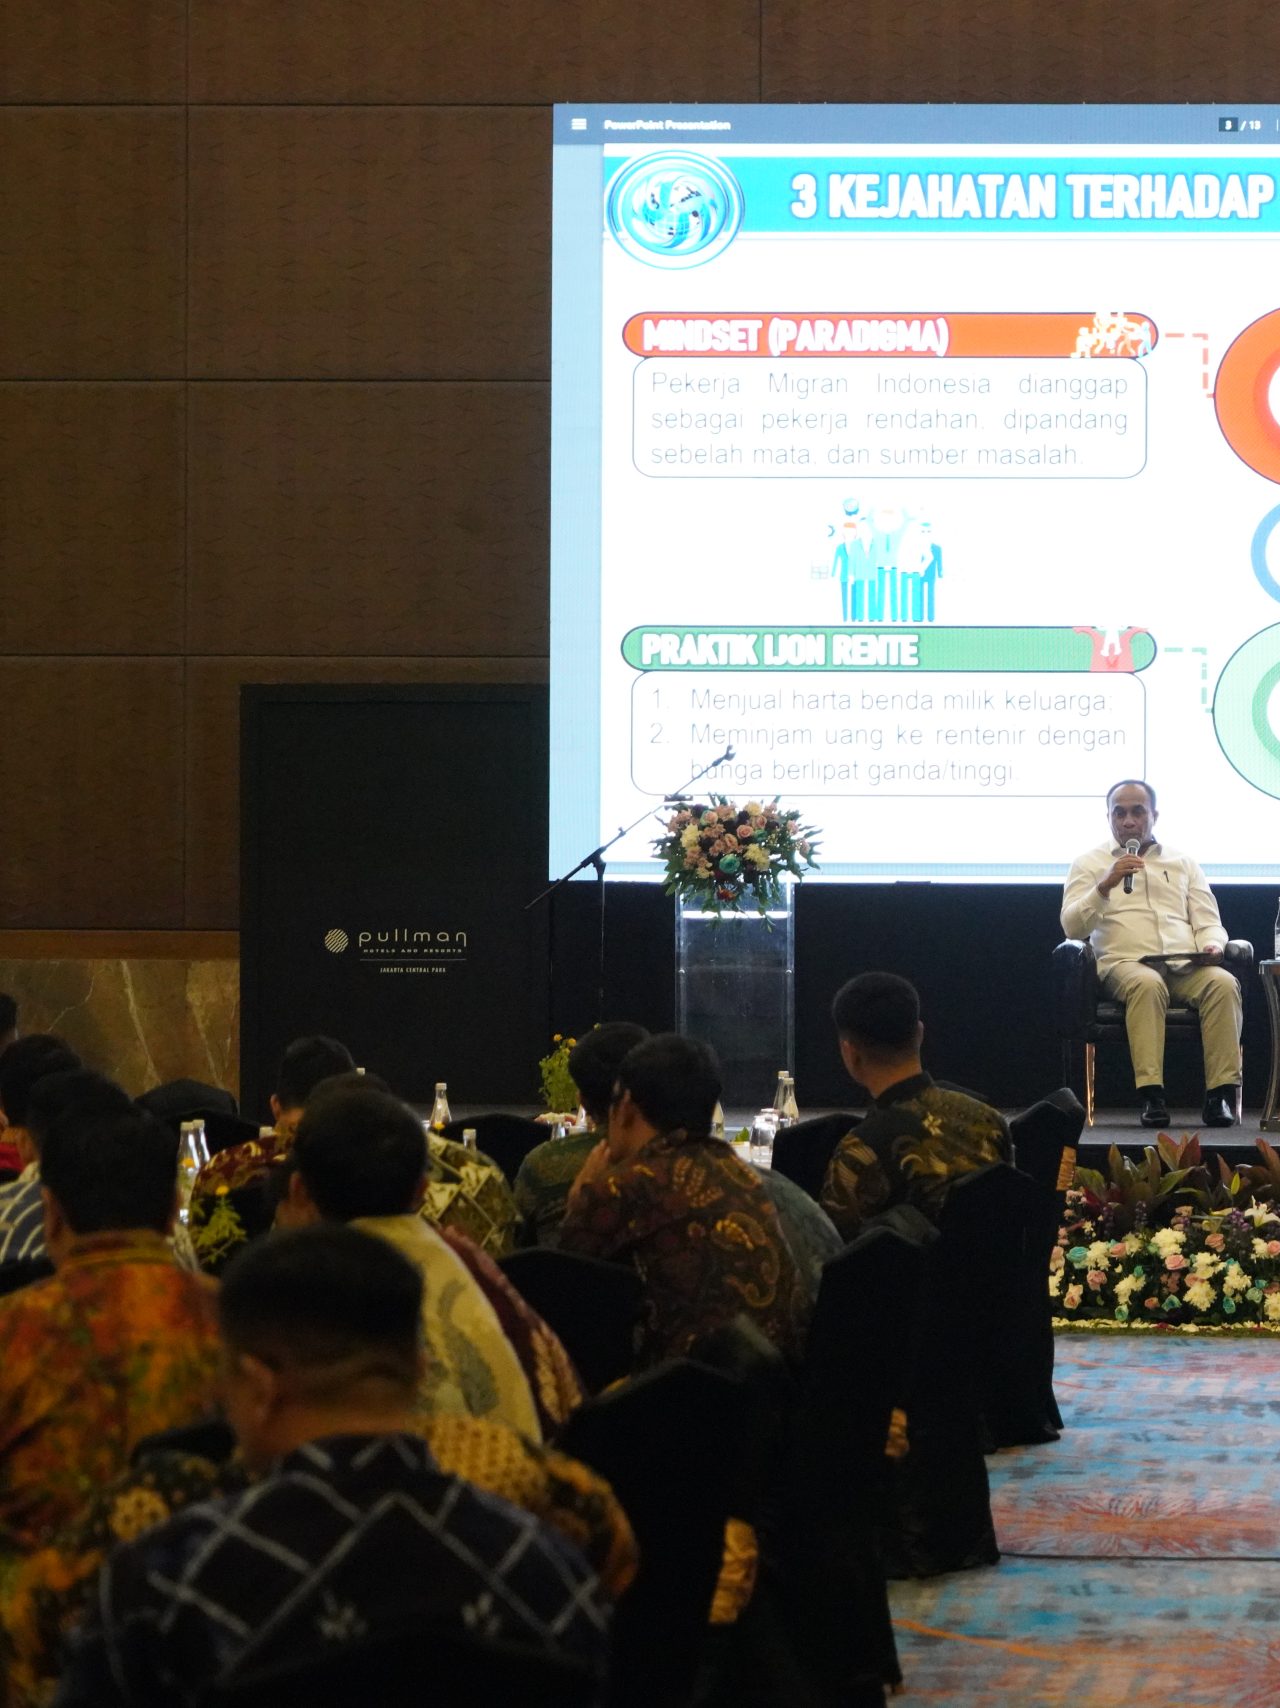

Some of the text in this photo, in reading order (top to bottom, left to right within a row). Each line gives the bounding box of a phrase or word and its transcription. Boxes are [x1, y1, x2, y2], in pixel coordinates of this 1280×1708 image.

[604, 119, 731, 130] PowerPoint Presentation
[1225, 120, 1232, 130] 3
[792, 174, 816, 217] 3
[830, 175, 1055, 217] KEJAHATAN
[1066, 175, 1273, 218] TERHADAP
[644, 318, 948, 356] MINDSET (PARADIGMA)
[653, 372, 1127, 400] Pekerja Migran Indonesia dianggap
[653, 409, 742, 434] sebagai
[763, 408, 847, 434] pekerja
[1004, 409, 1127, 435] dipandang
[652, 444, 742, 464] sebelah
[828, 444, 869, 464] dan
[881, 444, 968, 464] sumber
[643, 634, 757, 664] PRAKTIK
[833, 635, 918, 665] RENTE
[692, 689, 781, 715] Menjual
[793, 691, 851, 709] harta
[862, 690, 932, 710] benda
[944, 690, 993, 709] milik
[692, 723, 811, 750] Meminjam
[826, 729, 882, 750] uang
[897, 725, 922, 744] ke
[937, 725, 1025, 745] rentenir
[1039, 726, 1125, 751] dengan
[691, 759, 762, 785] bunga
[773, 760, 858, 784] berlipat
[359, 929, 466, 947] pullman
